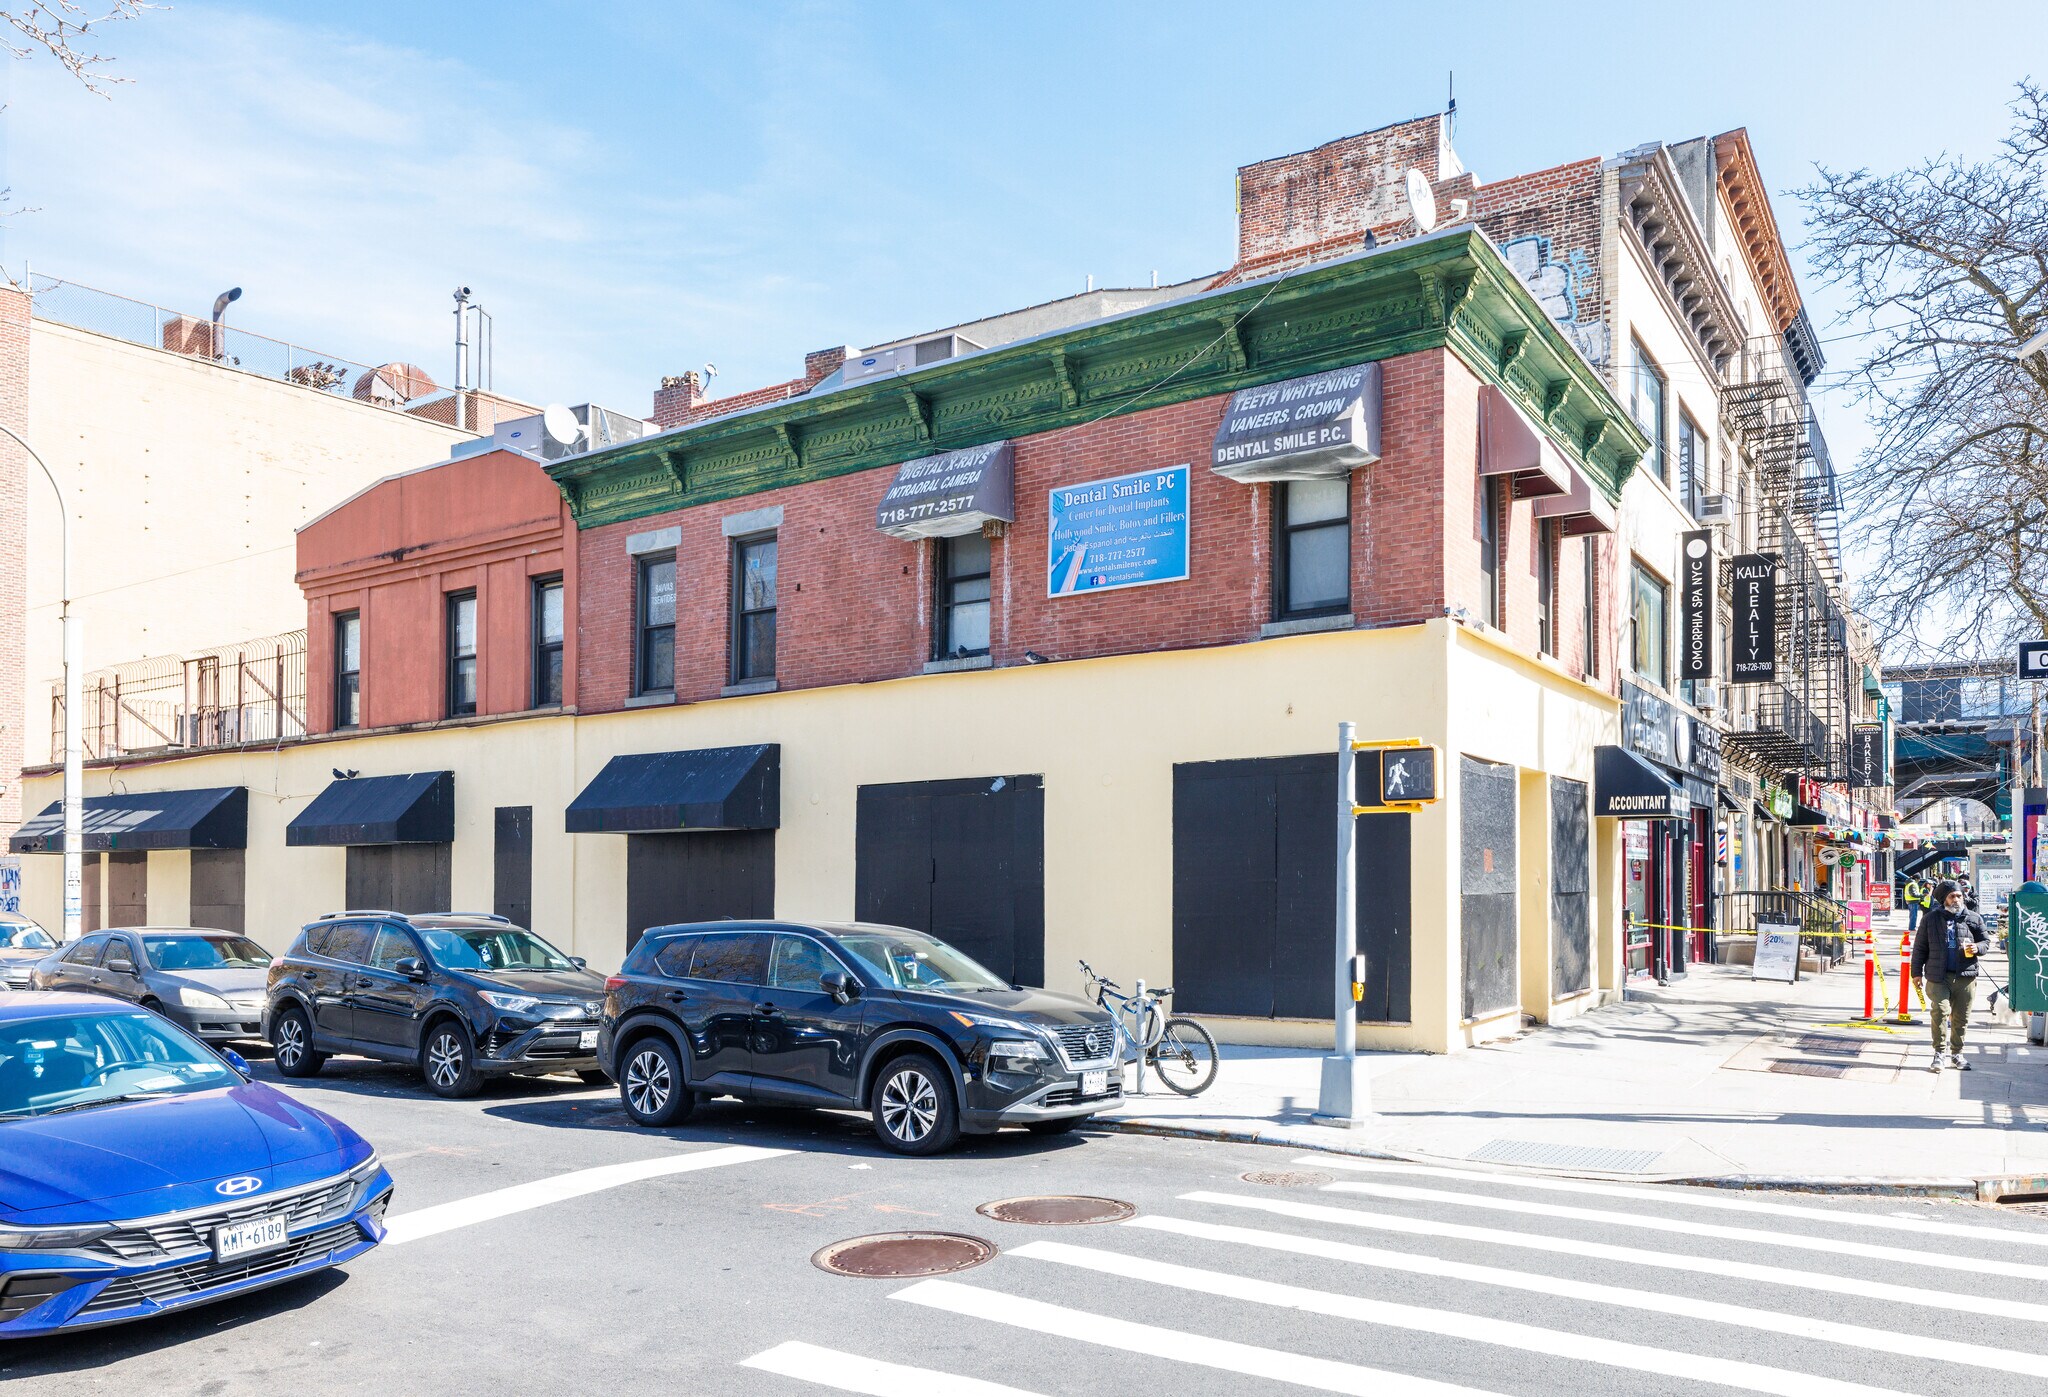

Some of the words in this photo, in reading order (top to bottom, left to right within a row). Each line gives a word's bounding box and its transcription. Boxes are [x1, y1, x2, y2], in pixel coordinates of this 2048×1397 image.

[1234, 391, 1279, 412] TEETH
[1279, 373, 1362, 402] WHITENING
[1295, 397, 1346, 421] CROWN
[1217, 441, 1270, 462] DENTAL
[1274, 431, 1316, 451] SMILE
[1320, 426, 1346, 443] P.C.
[899, 461, 943, 481] DIGITAL
[945, 452, 989, 472] X-RAYS
[887, 479, 940, 500] INTRAORAL
[940, 470, 982, 490] CAMERA
[1064, 486, 1107, 507] Dental
[1112, 480, 1151, 498] Smile
[1156, 474, 1175, 491] PC
[880, 495, 974, 524] 718-777-2577
[1069, 508, 1094, 521] Center
[1095, 507, 1107, 517] for
[1108, 502, 1133, 515] Dental
[1135, 496, 1170, 511] Implants
[1054, 525, 1093, 541] Hollywood
[1120, 518, 1141, 529] Botox
[1143, 516, 1158, 526] and
[1160, 512, 1185, 524] Fillers
[1114, 536, 1127, 545] and
[1079, 558, 1158, 575] www.dentalsmilenyc.com
[1089, 547, 1146, 564] 718-777-2577
[1108, 571, 1144, 582] dentalsmile
[1692, 561, 1703, 586] NYC
[1736, 564, 1773, 580] KALLY
[1692, 588, 1703, 608] SPA
[1692, 610, 1703, 670] OMORPHIA
[1736, 661, 1773, 672] 718-726-7600
[1609, 795, 1667, 811] ACCOUNTANT
